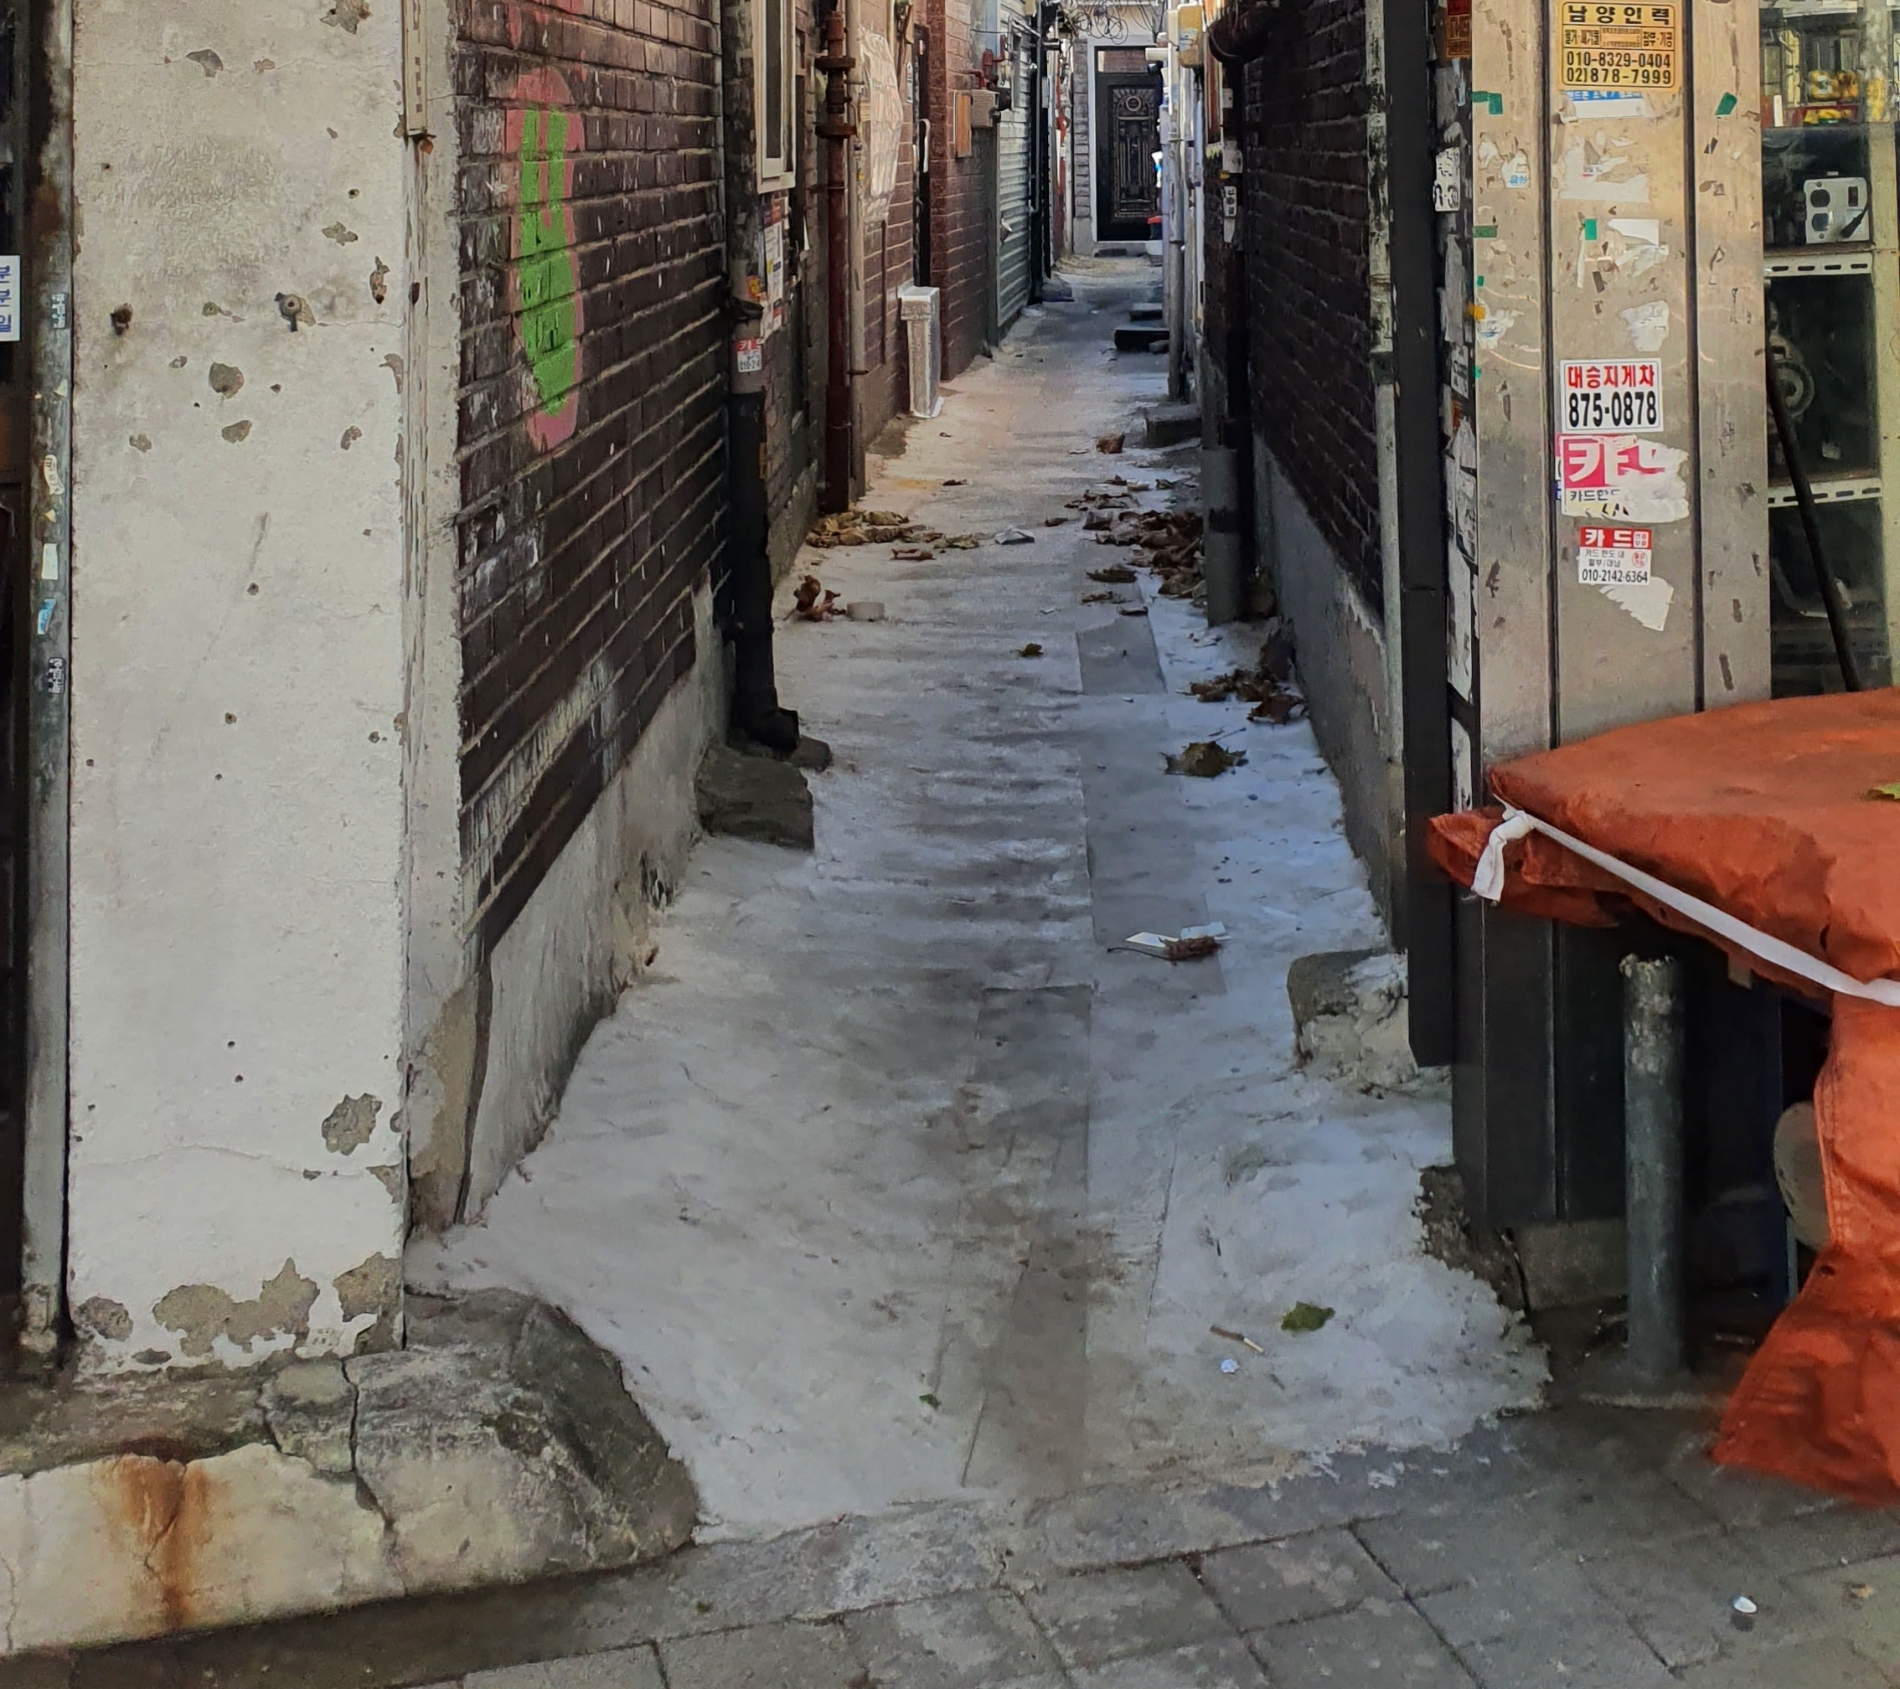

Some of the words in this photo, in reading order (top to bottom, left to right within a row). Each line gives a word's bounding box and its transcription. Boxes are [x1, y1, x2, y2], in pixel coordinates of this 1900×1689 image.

[1567, 4, 1670, 26] 남양인력
[1566, 51, 1671, 68] 010-8329-0404
[1566, 67, 1672, 85] 02)878-7999
[1566, 364, 1655, 389] 대승지게차
[1568, 390, 1658, 428] 875-0878
[1584, 528, 1632, 548] 카드
[1581, 568, 1649, 584] 010-2142-6364
